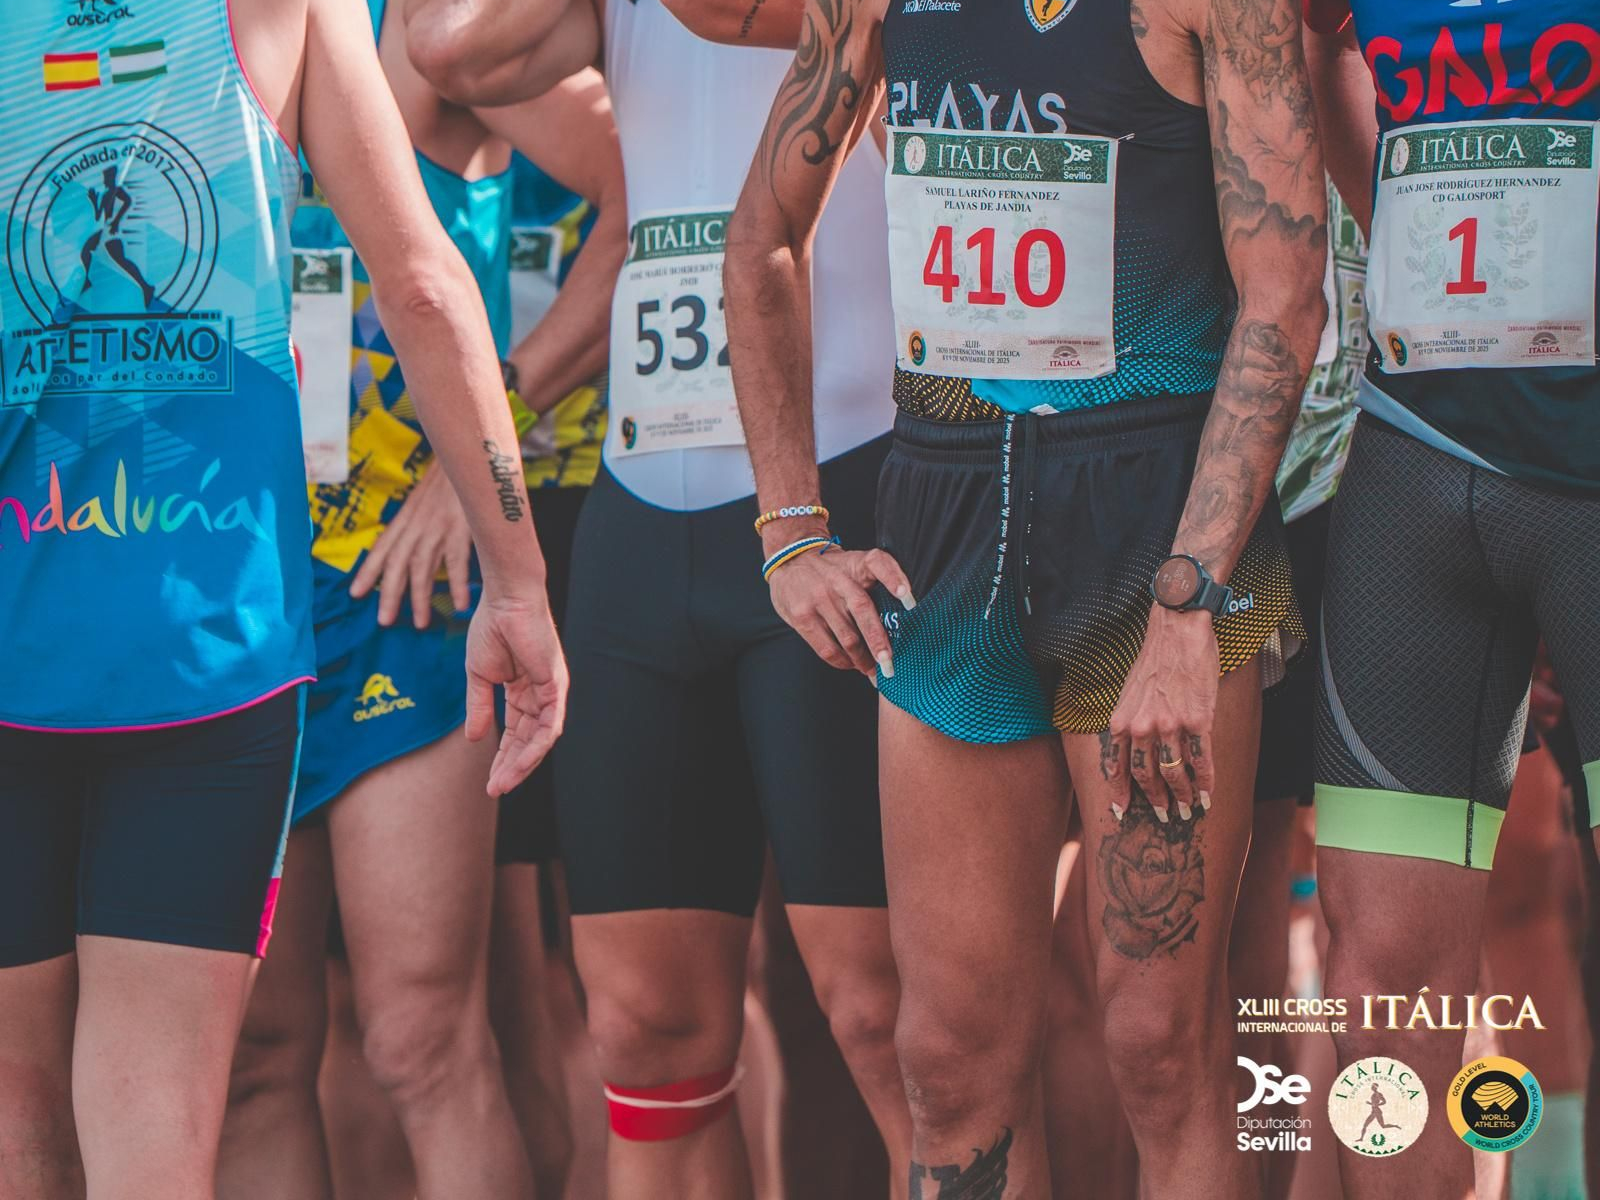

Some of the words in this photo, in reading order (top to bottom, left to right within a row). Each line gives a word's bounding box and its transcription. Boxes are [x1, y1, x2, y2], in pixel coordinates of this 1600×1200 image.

[67, 6, 135, 26] austral
[1365, 22, 1600, 123] GALO
[937, 139, 1044, 172] ITÁLICA
[1421, 131, 1526, 163] ITÁLICA
[52, 146, 118, 189] Fundada
[1420, 162, 1468, 171] INTERNATIONAL
[1546, 157, 1576, 166] Sevilla
[937, 170, 985, 178] INTERNATIONAL
[1063, 171, 1092, 180] Sevilla
[925, 186, 957, 198] SAMUEL
[959, 187, 996, 199] LARIÑO
[998, 190, 1060, 201] FERNANDEZ
[1396, 183, 1414, 195] JUAN
[1415, 182, 1434, 192] JOSE
[1436, 176, 1493, 191] RODRÍGUEZ
[1494, 177, 1562, 188] HERNANDEZ
[944, 200, 977, 211] PLAYAS
[980, 202, 994, 211] DE
[996, 202, 1032, 213] JANDIA
[1432, 193, 1445, 203] CD
[1447, 191, 1506, 202] GALOSPORT
[643, 219, 726, 252] ITÁLIC
[1446, 217, 1487, 295] 1
[923, 225, 1066, 308] 410
[949, 347, 986, 357] INTERNACIONAL
[77, 374, 102, 387] par
[111, 369, 136, 382] del
[144, 369, 217, 383] Condado
[0, 457, 271, 544] ndalucía
